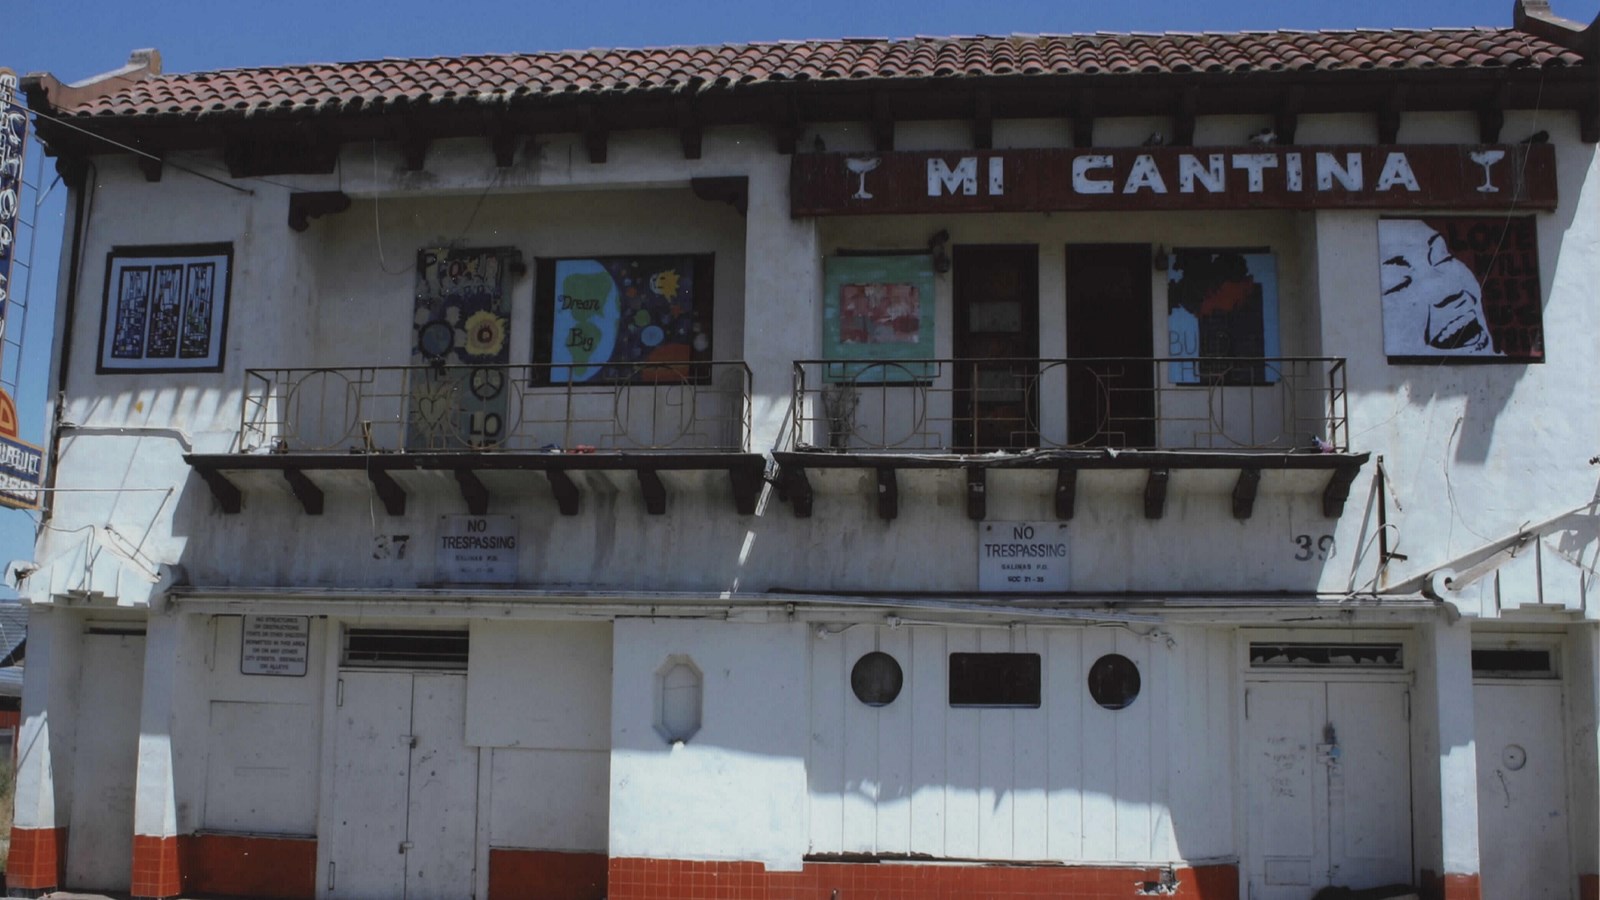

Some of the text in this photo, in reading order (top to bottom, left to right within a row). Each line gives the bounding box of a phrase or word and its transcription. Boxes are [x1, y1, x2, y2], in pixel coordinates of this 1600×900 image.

[927, 152, 1421, 196] MI CANTINA
[566, 327, 594, 352] Big
[467, 519, 487, 533] NO
[1013, 526, 1035, 540] NO
[373, 534, 410, 560] 37
[442, 536, 516, 549] TRESPASSING
[984, 543, 1067, 557] TRESPASSING
[1295, 534, 1337, 561] 39
